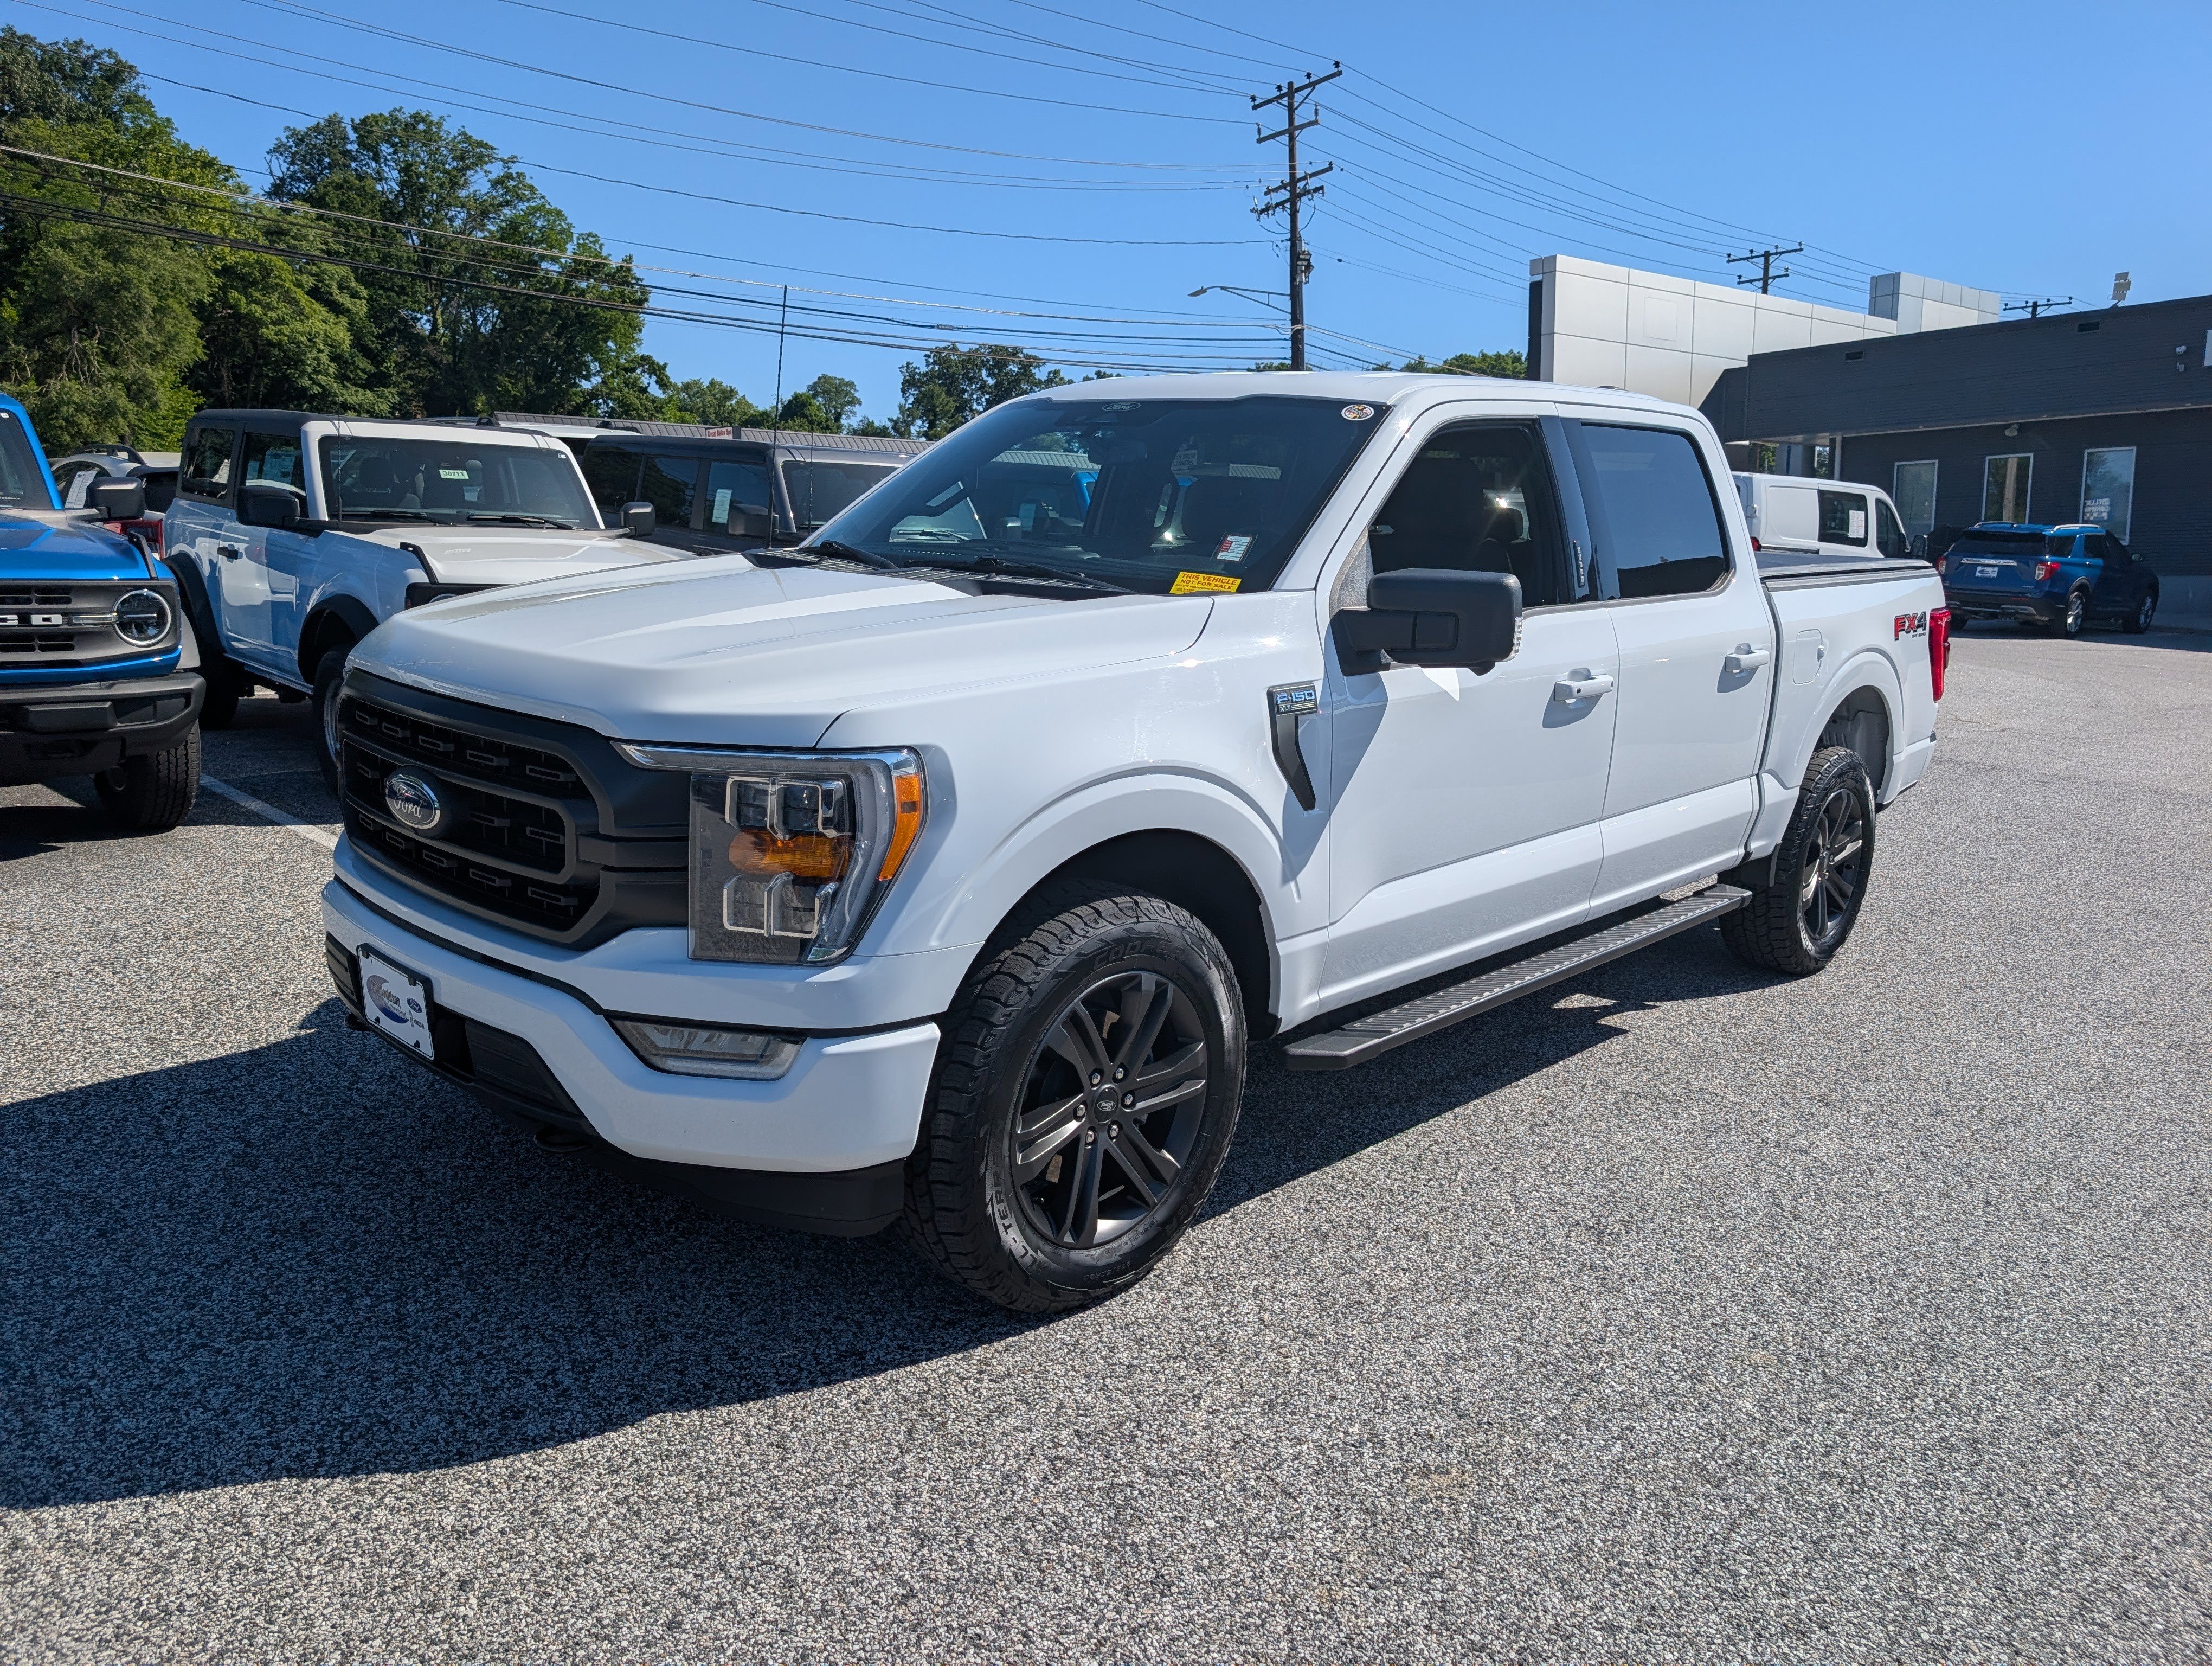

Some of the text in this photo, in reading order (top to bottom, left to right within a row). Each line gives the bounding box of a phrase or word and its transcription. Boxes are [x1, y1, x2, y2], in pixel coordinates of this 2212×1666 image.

[1203, 575, 1238, 585] VEHICLE
[1894, 611, 1927, 641] FX4
[1277, 690, 1315, 704] F-150
[1094, 940, 1185, 970] COOPER
[381, 988, 401, 1009] Davidson
